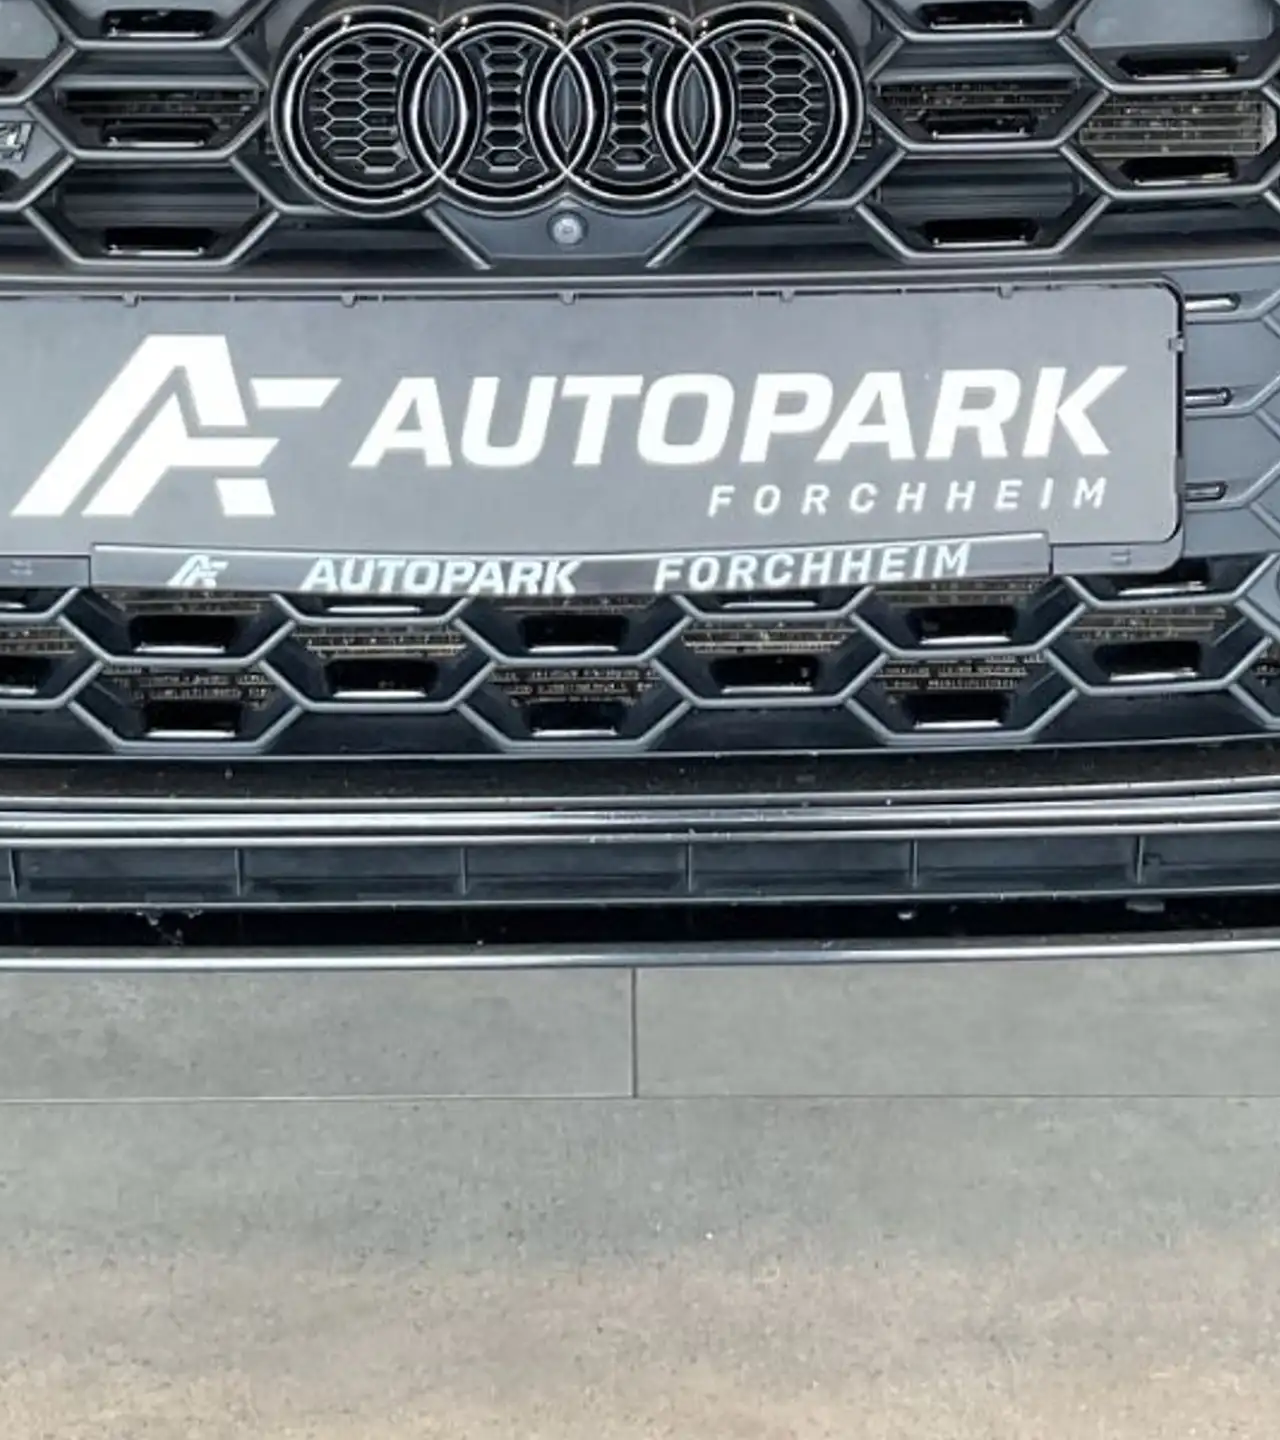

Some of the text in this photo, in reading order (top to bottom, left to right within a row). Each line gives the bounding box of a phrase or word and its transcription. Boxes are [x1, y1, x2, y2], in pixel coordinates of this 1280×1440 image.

[349, 366, 1128, 467] AUTOPARK
[707, 477, 1107, 517] FORCHHEIM
[299, 557, 582, 595] AUTOPARK
[653, 543, 970, 592] FORCHHEIM
